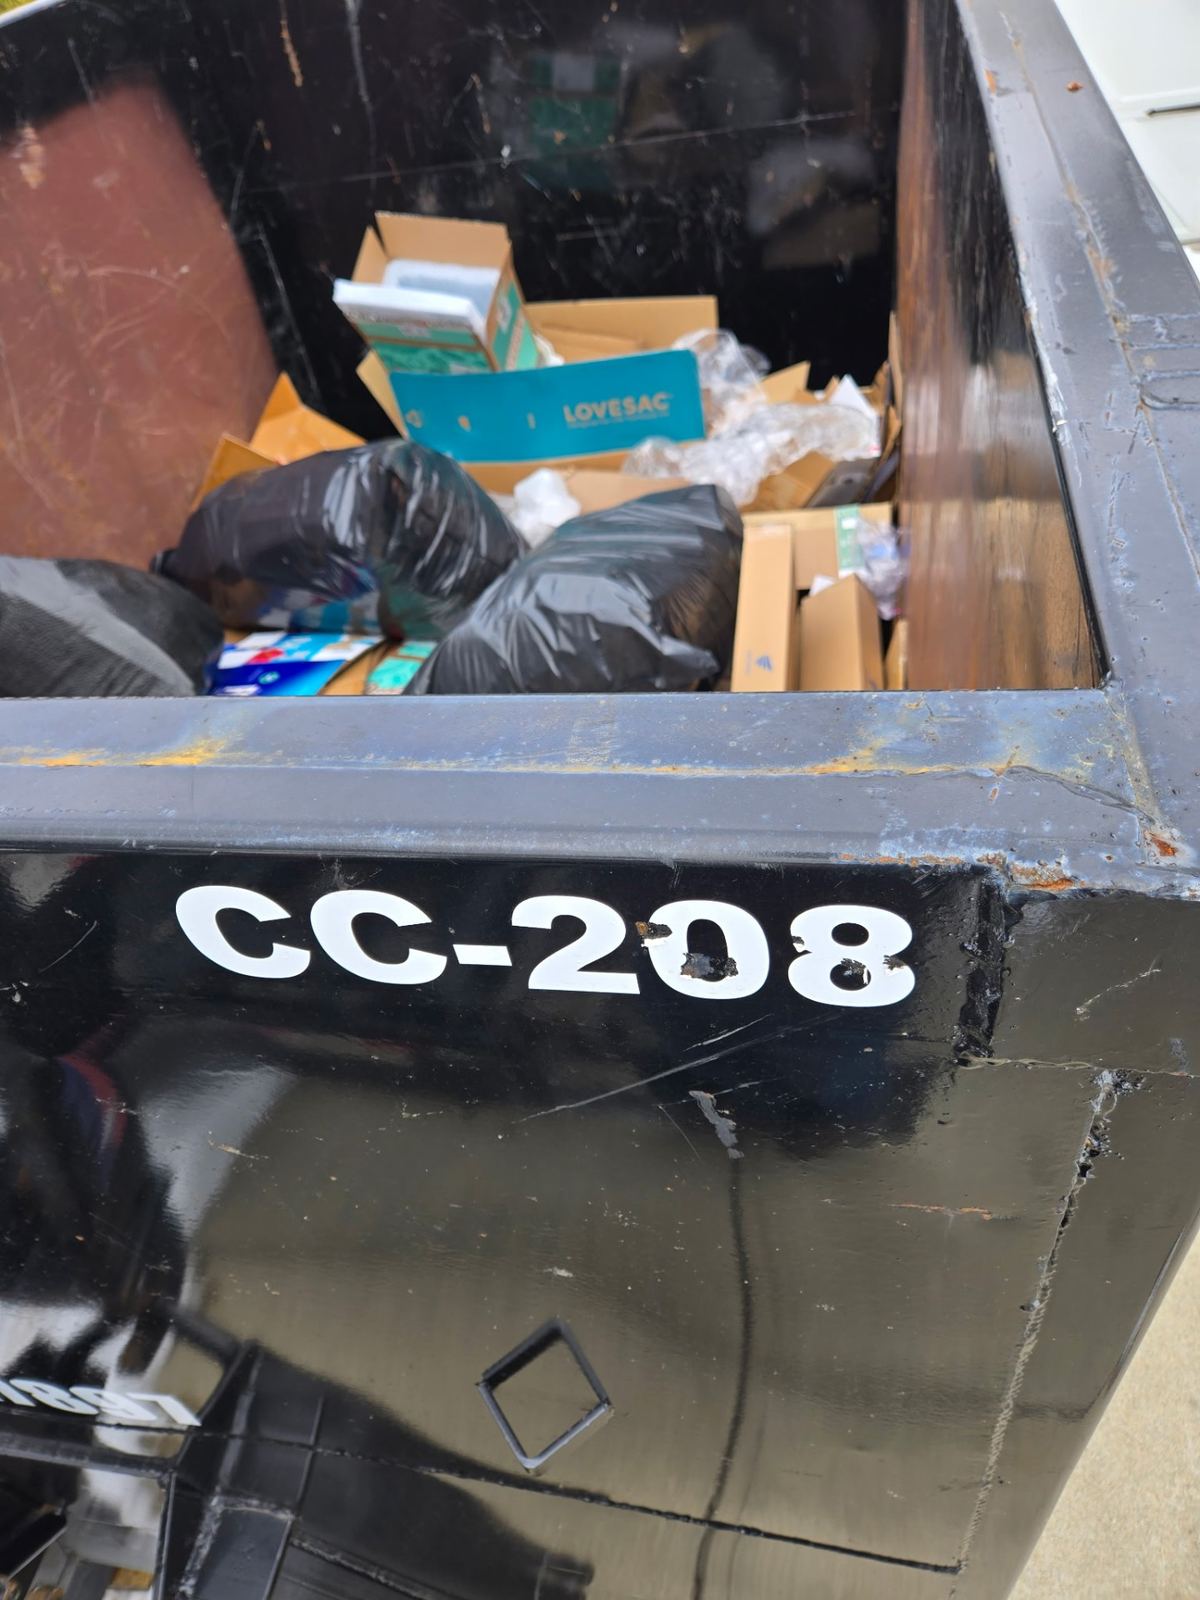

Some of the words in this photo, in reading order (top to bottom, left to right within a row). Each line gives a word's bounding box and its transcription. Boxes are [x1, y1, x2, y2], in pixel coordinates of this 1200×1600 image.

[563, 392, 671, 424] LOVESAC
[175, 885, 916, 1008] CC-208
[0, 1378, 202, 1427] 1897
